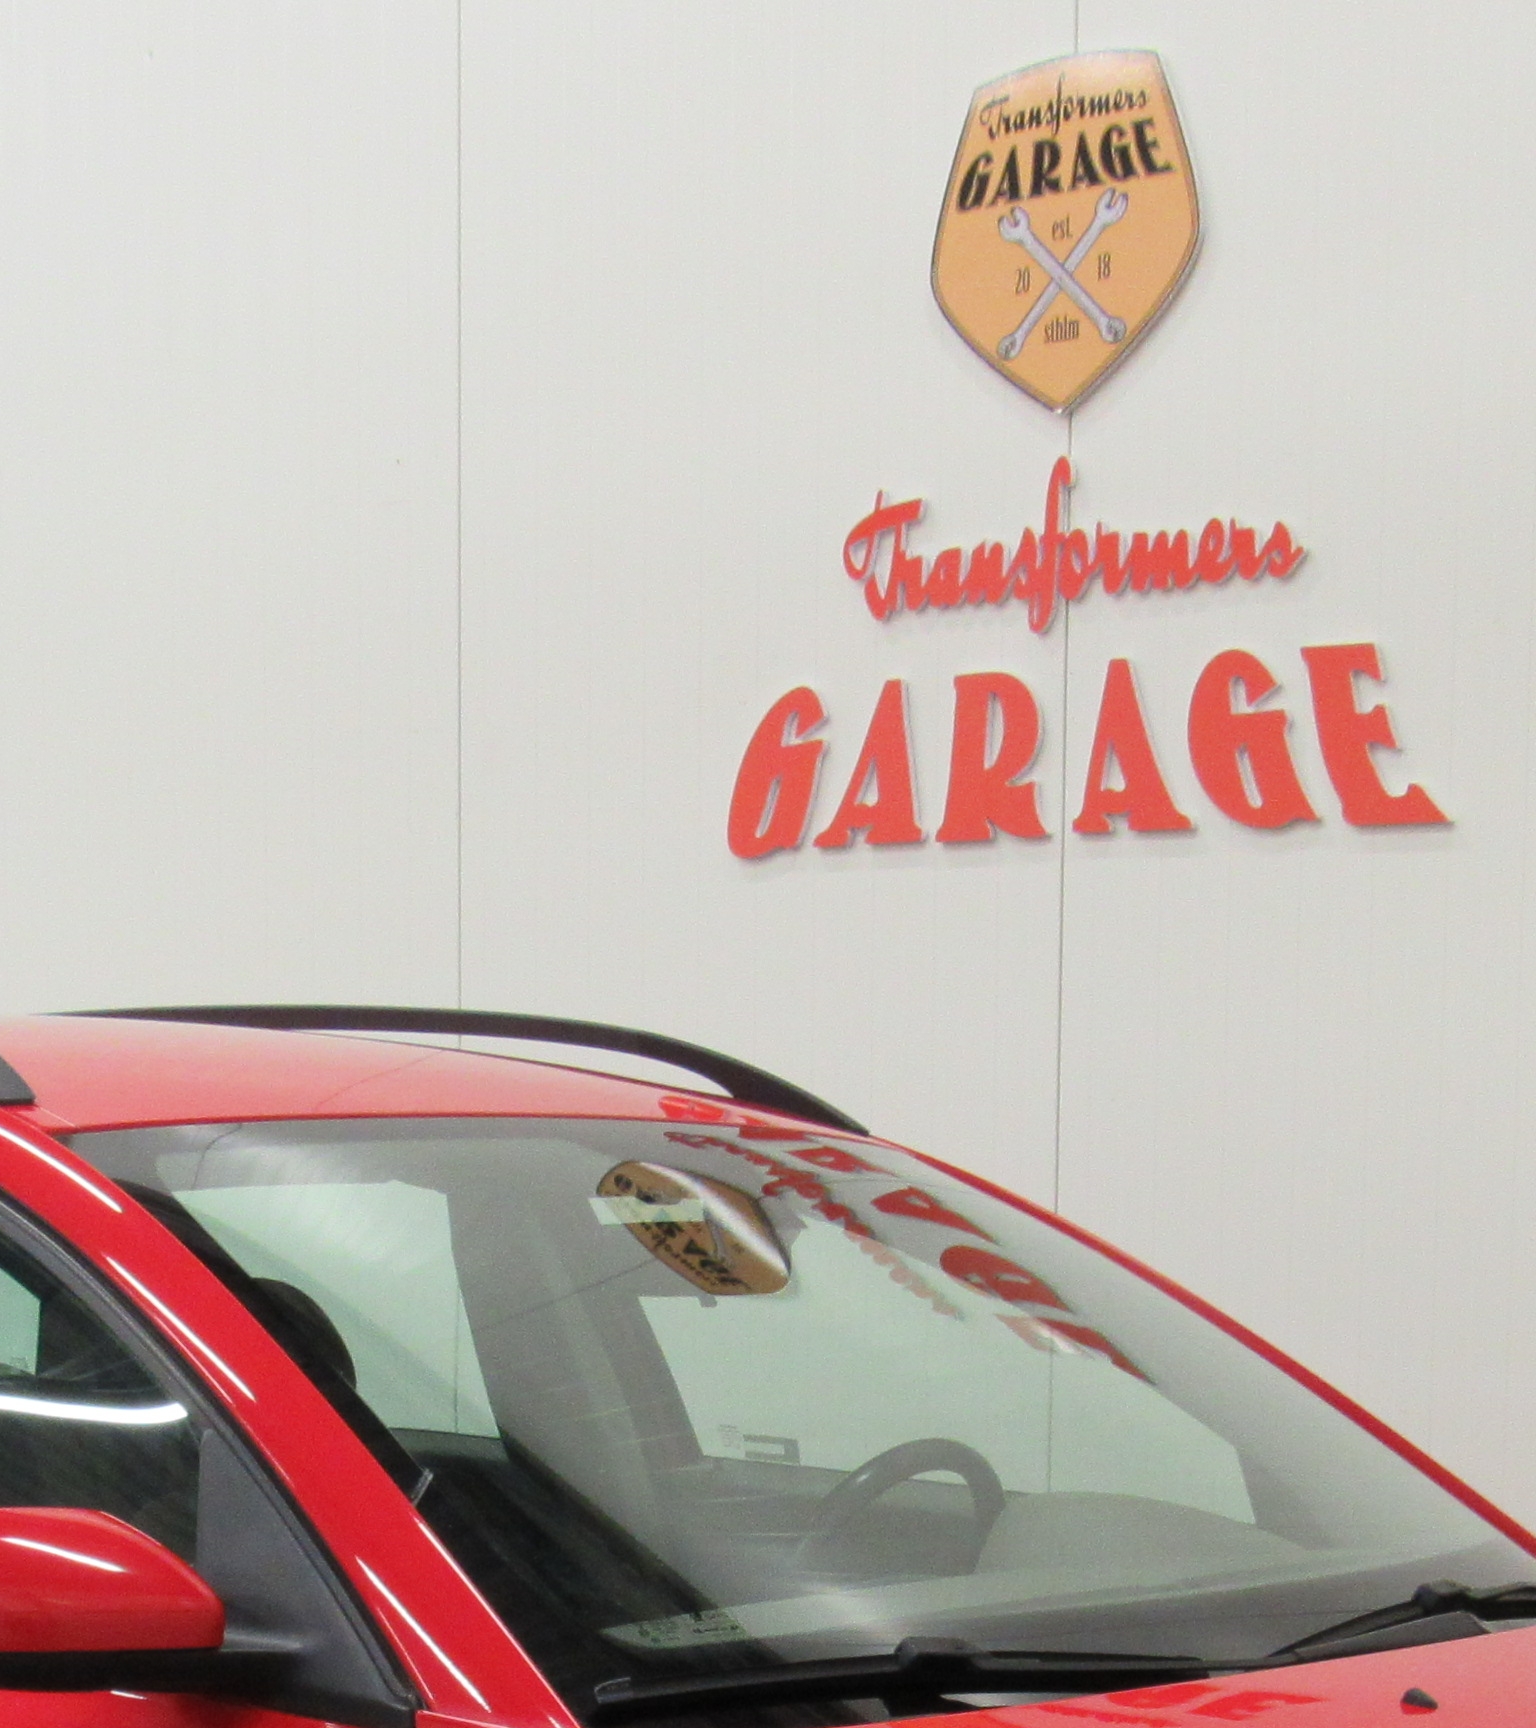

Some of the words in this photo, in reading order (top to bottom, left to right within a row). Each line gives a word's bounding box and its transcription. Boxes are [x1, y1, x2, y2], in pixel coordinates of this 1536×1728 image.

[980, 73, 1148, 140] Transformers
[955, 117, 1176, 213] GARAGE
[1015, 266, 1031, 295] 20
[1097, 252, 1112, 281] 18
[843, 456, 1308, 634] Transformers
[727, 643, 1455, 859] GARAGE
